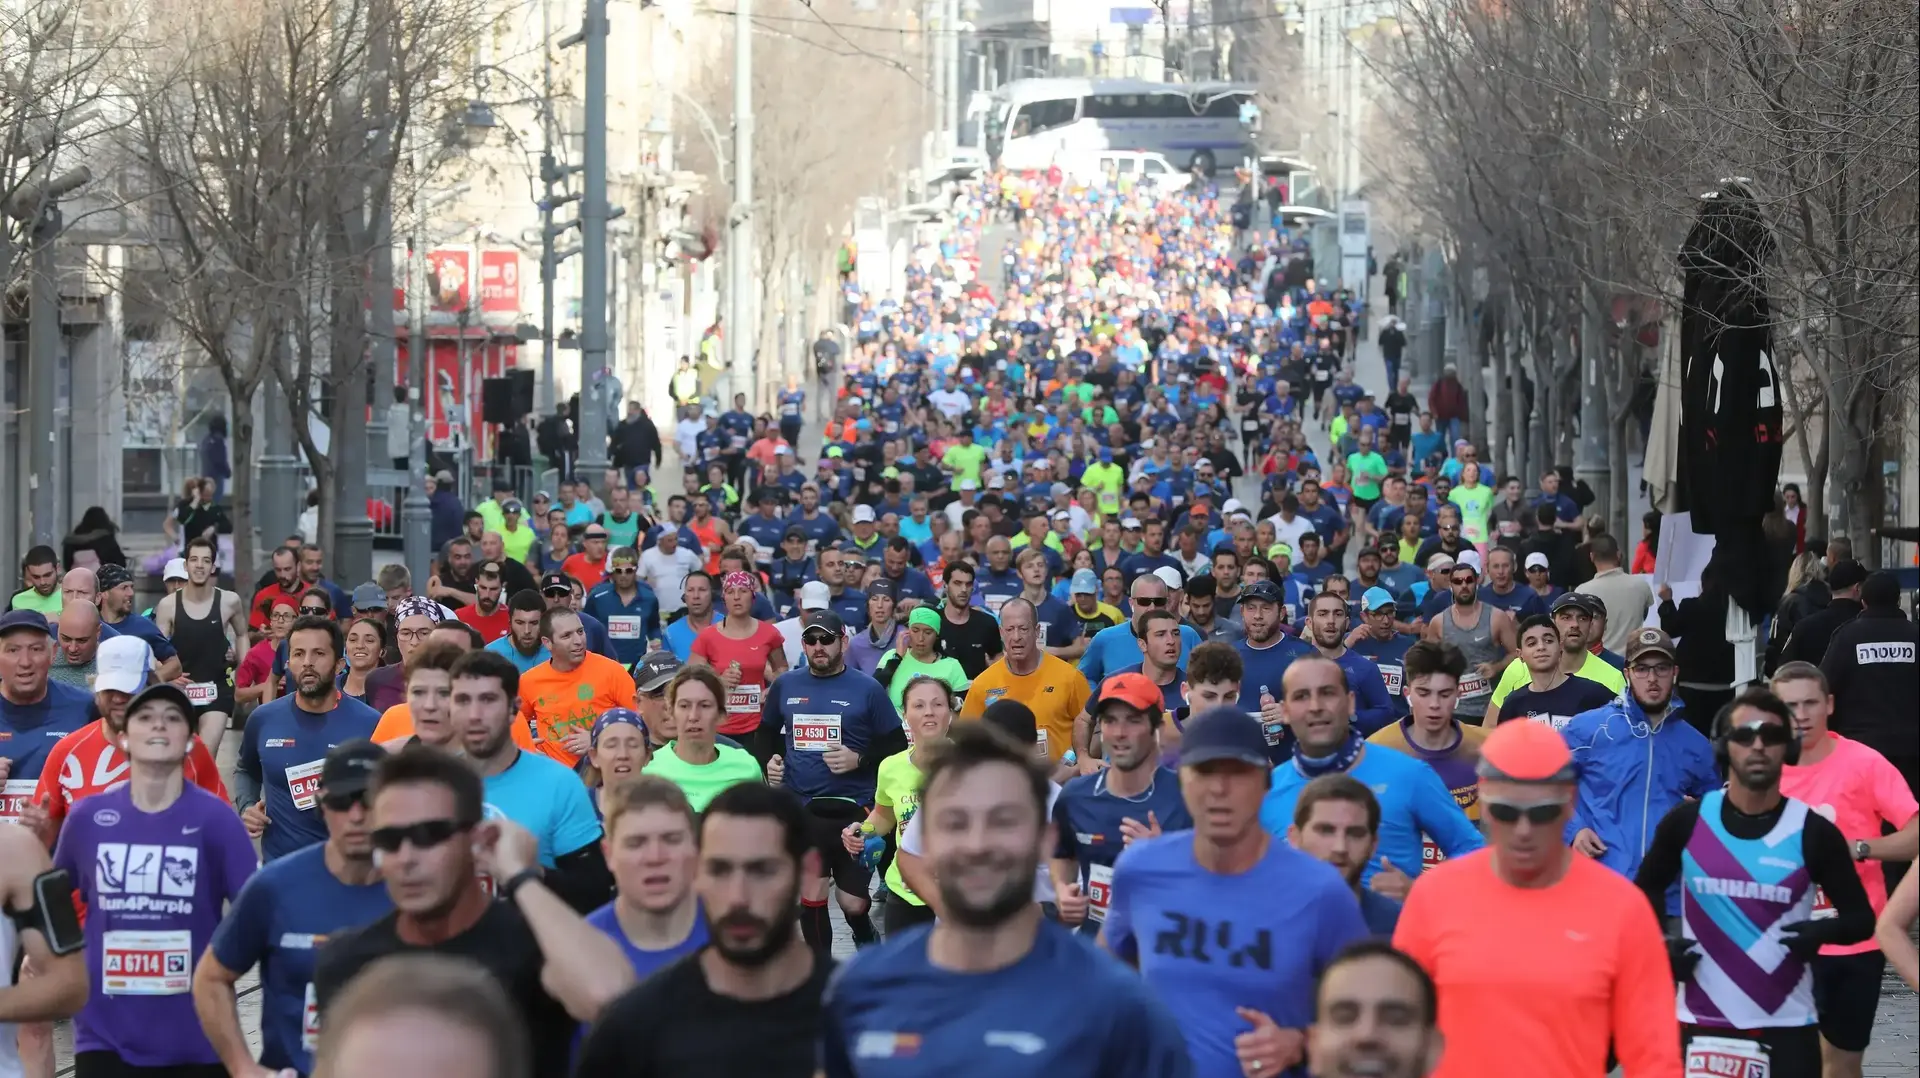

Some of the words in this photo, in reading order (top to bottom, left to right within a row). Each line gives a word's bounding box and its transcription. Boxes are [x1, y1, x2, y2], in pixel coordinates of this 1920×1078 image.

[1859, 647, 1913, 659] משטרה
[731, 695, 747, 704] 2327
[805, 727, 824, 739] 4530
[294, 784, 302, 794] C
[124, 953, 159, 973] 6714
